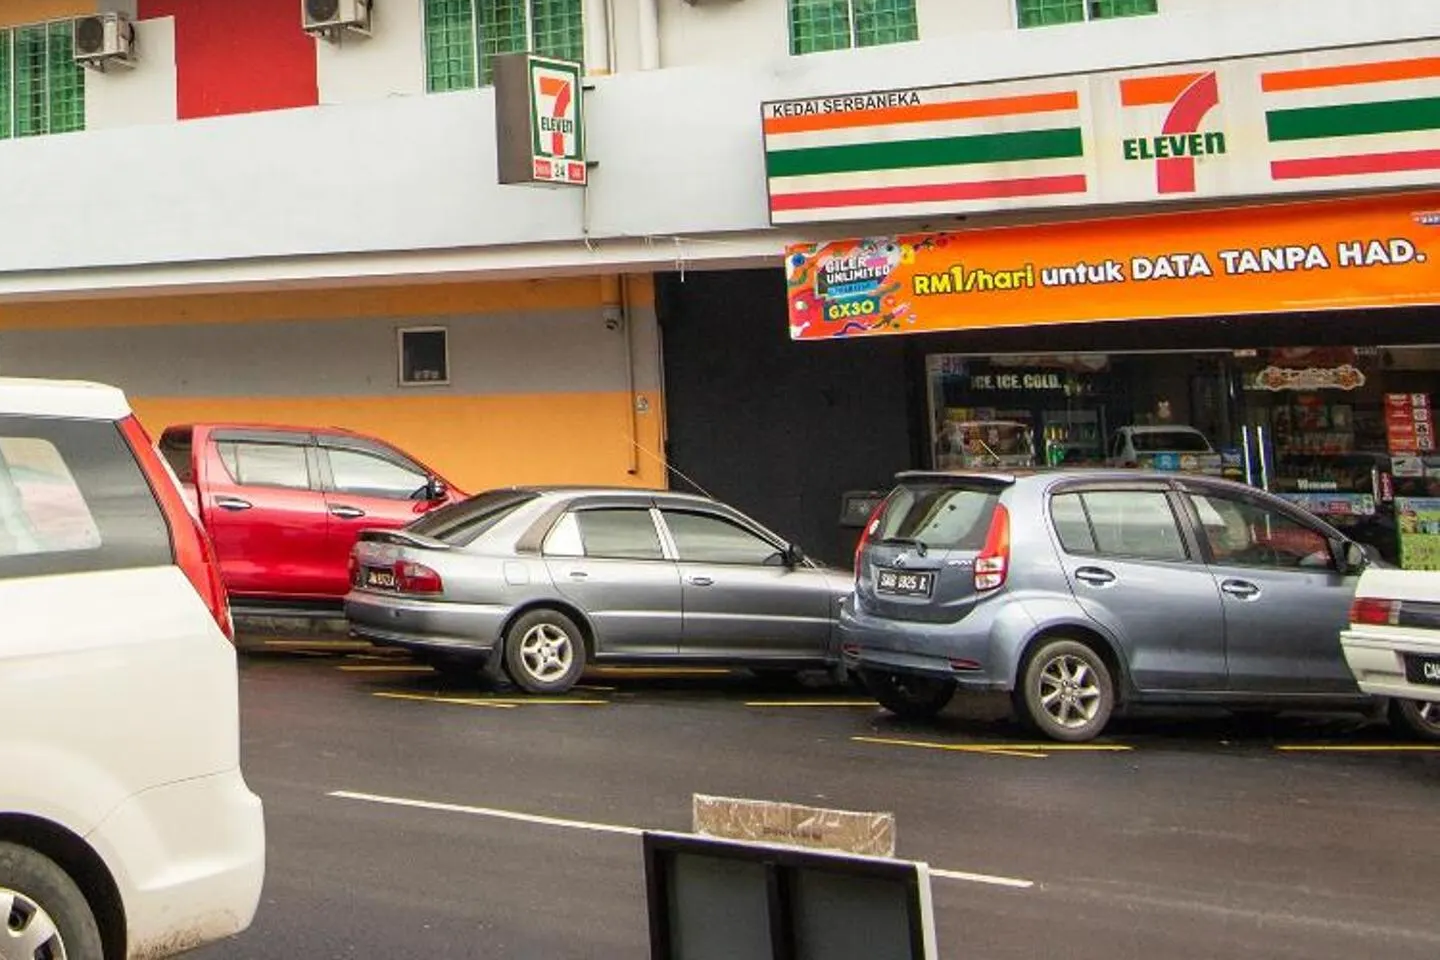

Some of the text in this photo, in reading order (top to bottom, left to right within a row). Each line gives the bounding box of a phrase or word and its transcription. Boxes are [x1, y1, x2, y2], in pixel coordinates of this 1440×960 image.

[539, 76, 571, 155] 7
[773, 92, 921, 118] KEDAI SERBANEKA
[1119, 71, 1220, 193] 7
[827, 266, 891, 284] UNLIMITED
[914, 239, 1427, 294] RM1/hari untuk DATA TANPA HAD.
[828, 299, 876, 319] GX30
